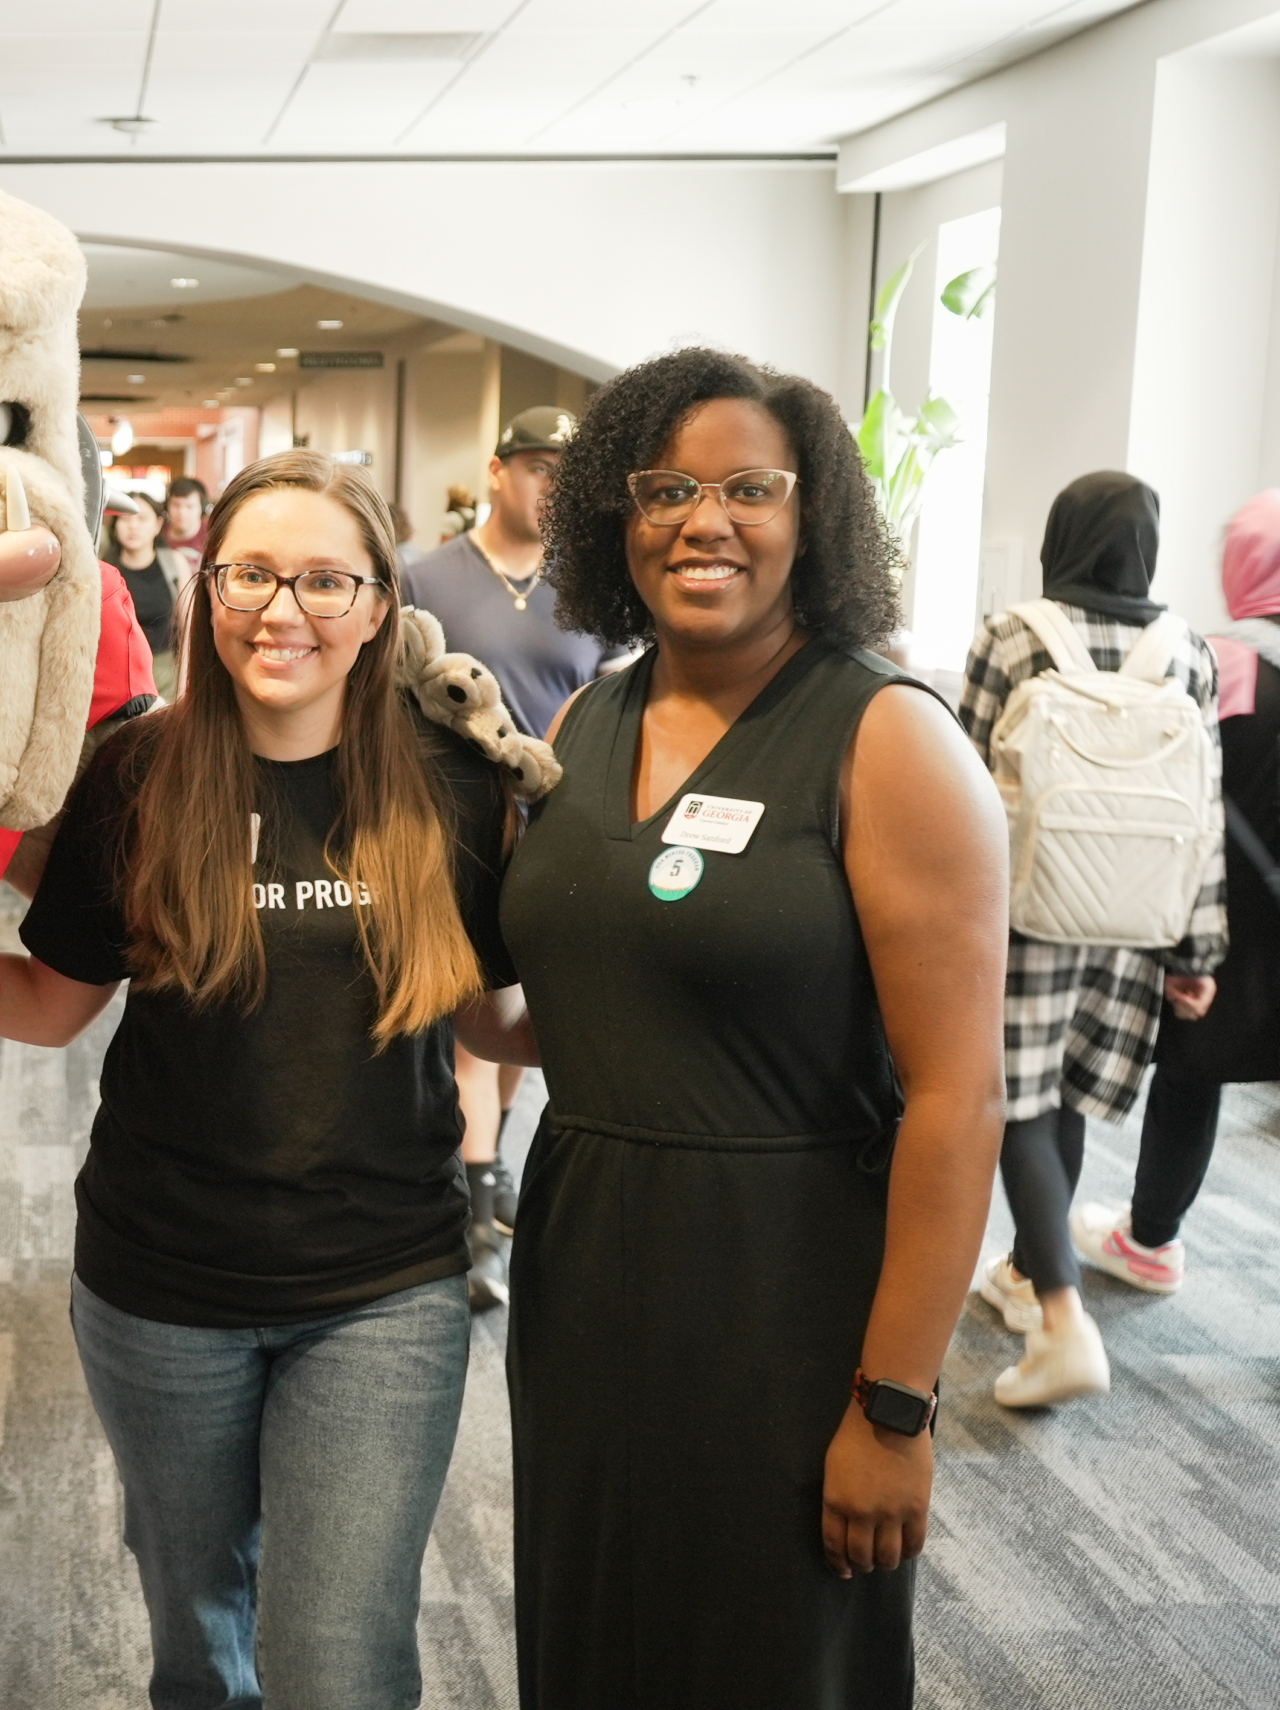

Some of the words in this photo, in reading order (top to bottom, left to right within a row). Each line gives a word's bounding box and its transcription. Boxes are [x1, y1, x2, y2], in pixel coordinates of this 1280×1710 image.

[702, 809, 750, 823] GEORGIA
[706, 804, 743, 814] UNIVERSITY
[680, 831, 701, 840] Drew
[702, 834, 732, 845] Sanford
[669, 859, 684, 877] 5
[295, 879, 374, 910] PROG
